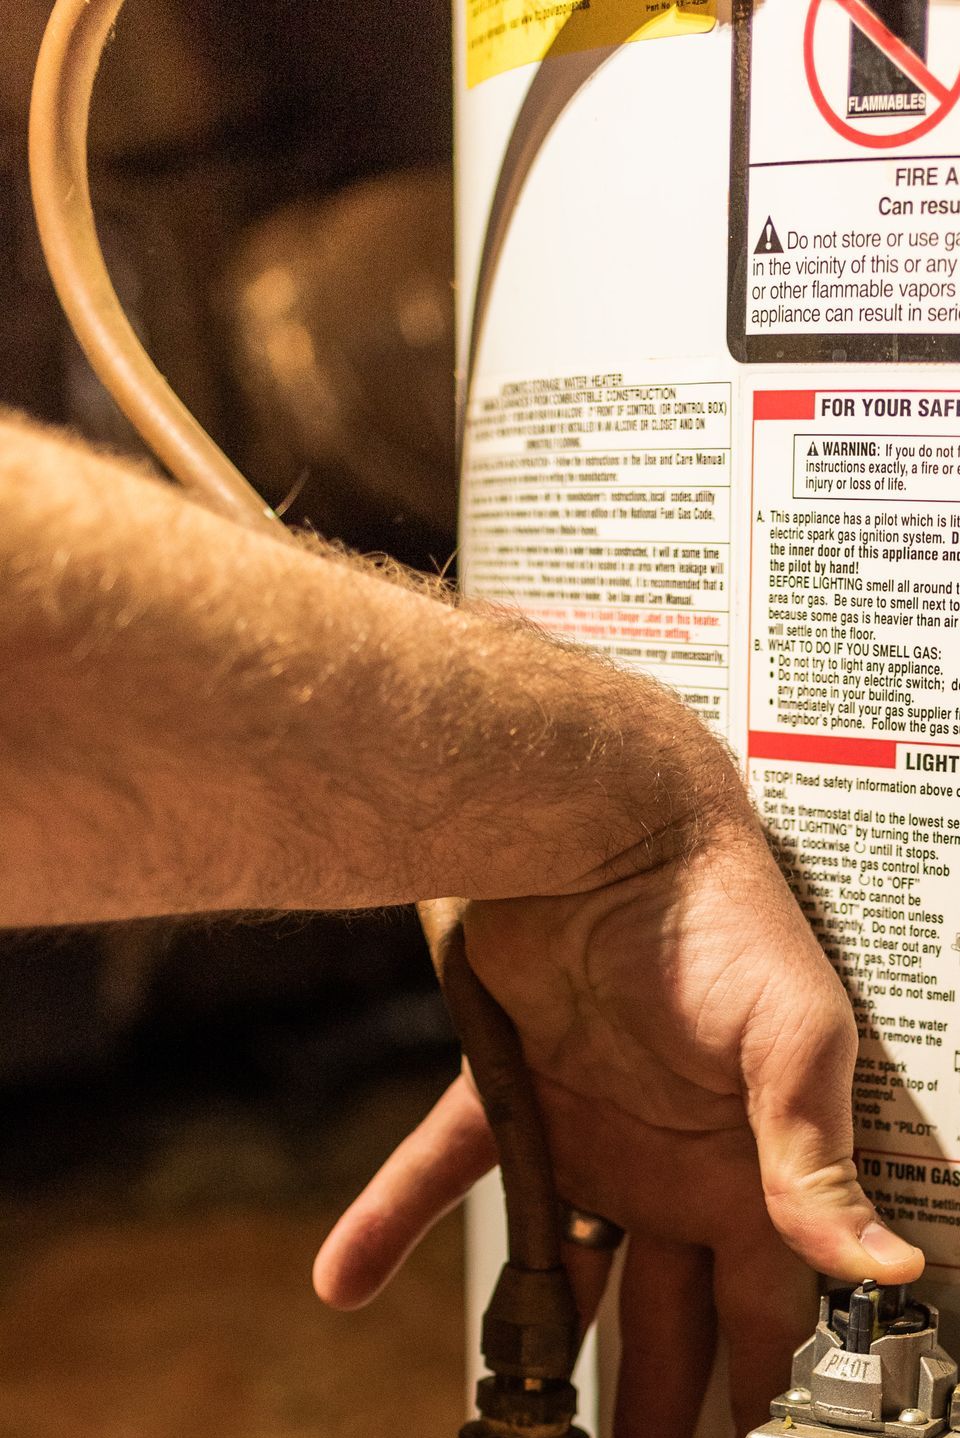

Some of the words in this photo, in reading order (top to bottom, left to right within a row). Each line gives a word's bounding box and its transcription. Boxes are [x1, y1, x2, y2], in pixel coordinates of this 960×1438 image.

[847, 93, 927, 114] FLAMMABLES
[894, 167, 939, 188] FIRE
[878, 195, 913, 216] Can
[786, 229, 809, 249] Do
[812, 229, 838, 249] not
[840, 228, 882, 249] store
[885, 232, 904, 248] or
[907, 232, 939, 248] use
[750, 303, 820, 328] appliance
[824, 307, 853, 323] can
[858, 302, 902, 322] result
[907, 302, 922, 322] in
[820, 397, 856, 418] FOR
[861, 398, 912, 419] YOUR
[821, 442, 881, 458] WARNING:
[884, 444, 893, 458] If
[894, 447, 916, 461] you
[917, 444, 933, 459] do
[934, 445, 954, 459] not
[804, 476, 834, 493] injury
[835, 480, 848, 491] or
[848, 477, 872, 491] loss
[873, 478, 885, 492] of
[886, 478, 907, 492] life.
[861, 1158, 882, 1178] TO
[885, 1161, 928, 1183] TURN
[824, 1354, 871, 1380] PILOT
